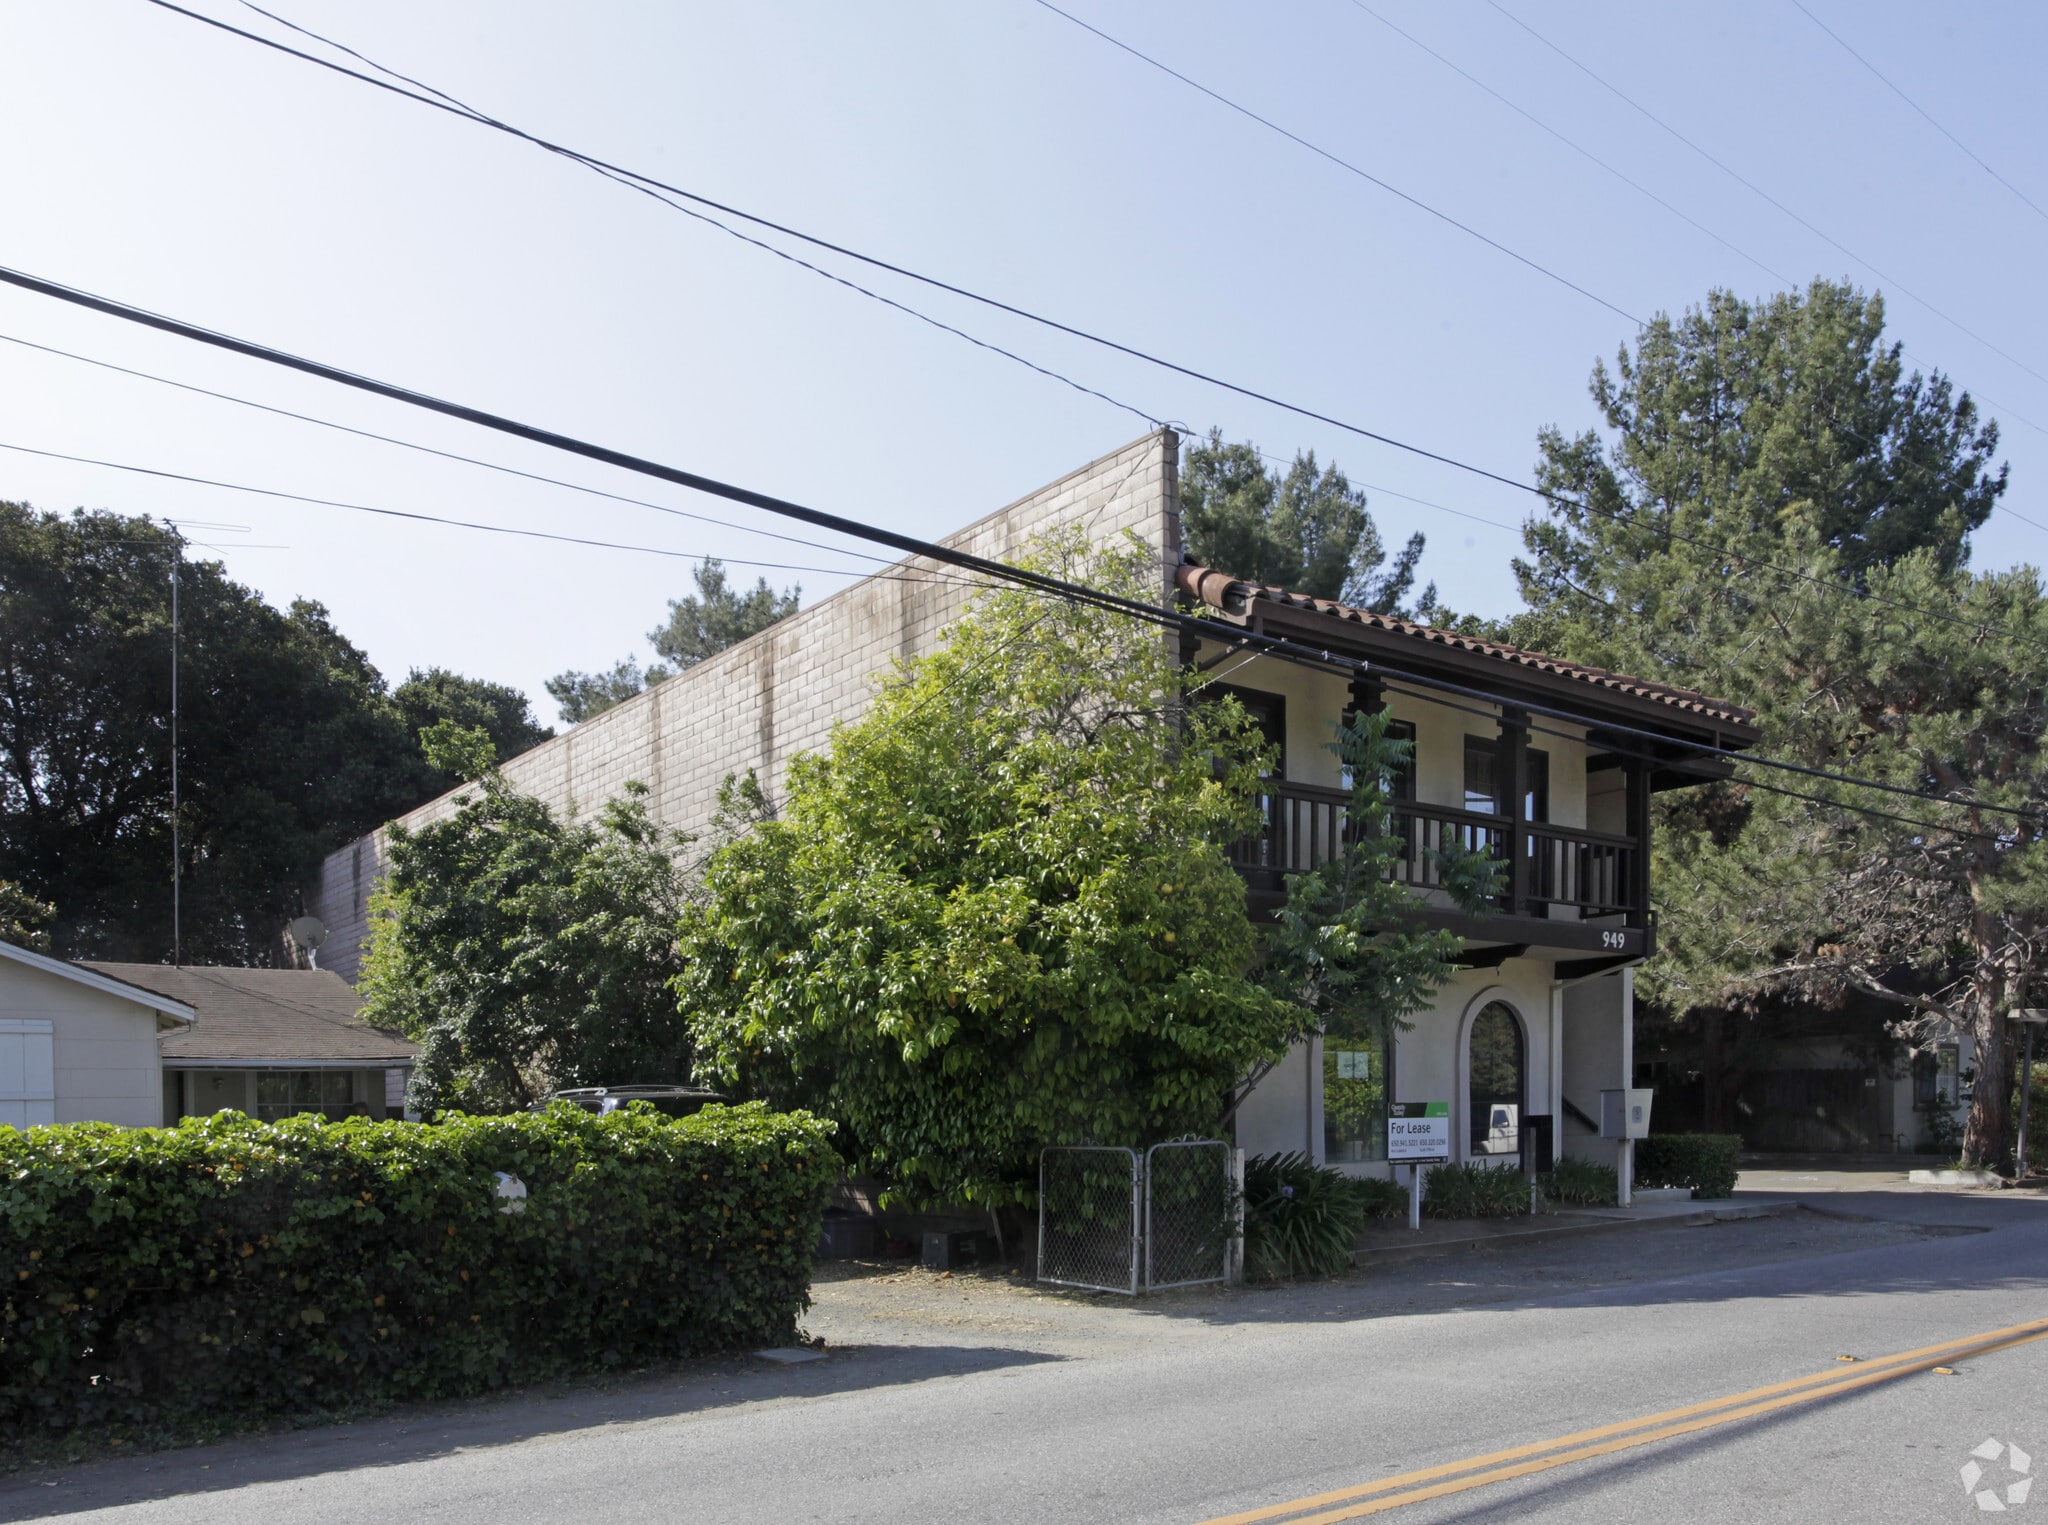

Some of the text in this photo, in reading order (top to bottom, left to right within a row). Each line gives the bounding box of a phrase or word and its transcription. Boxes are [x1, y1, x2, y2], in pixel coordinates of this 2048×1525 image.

[1603, 931, 1625, 949] 949
[1391, 1122, 1431, 1134] For Lease
